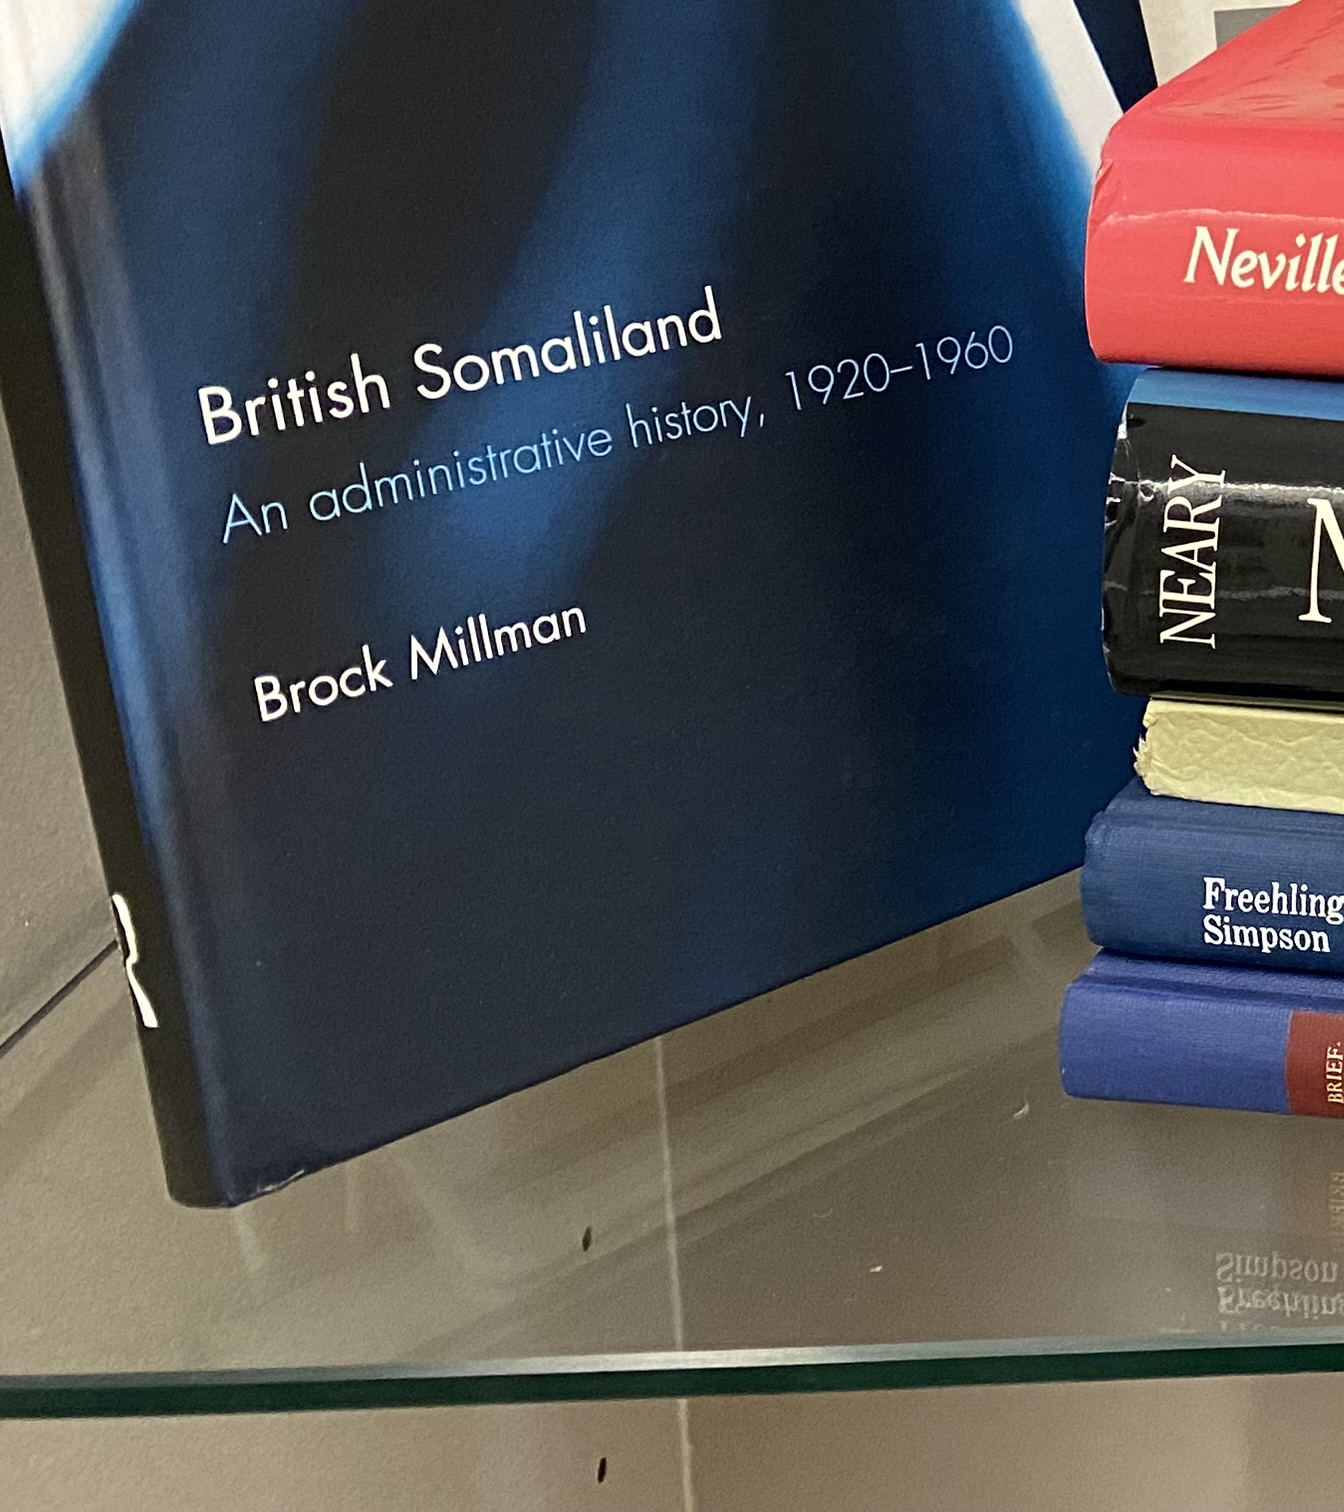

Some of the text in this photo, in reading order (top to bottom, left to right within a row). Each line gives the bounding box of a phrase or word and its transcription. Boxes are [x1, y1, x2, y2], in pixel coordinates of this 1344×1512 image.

[198, 286, 723, 446] British Somaliland
[222, 494, 289, 544] An
[310, 426, 613, 522] administrative
[627, 392, 766, 452] history,
[1159, 454, 1226, 650] NEARY
[254, 603, 587, 723] Brock Millman
[1203, 915, 1330, 953] Simpson
